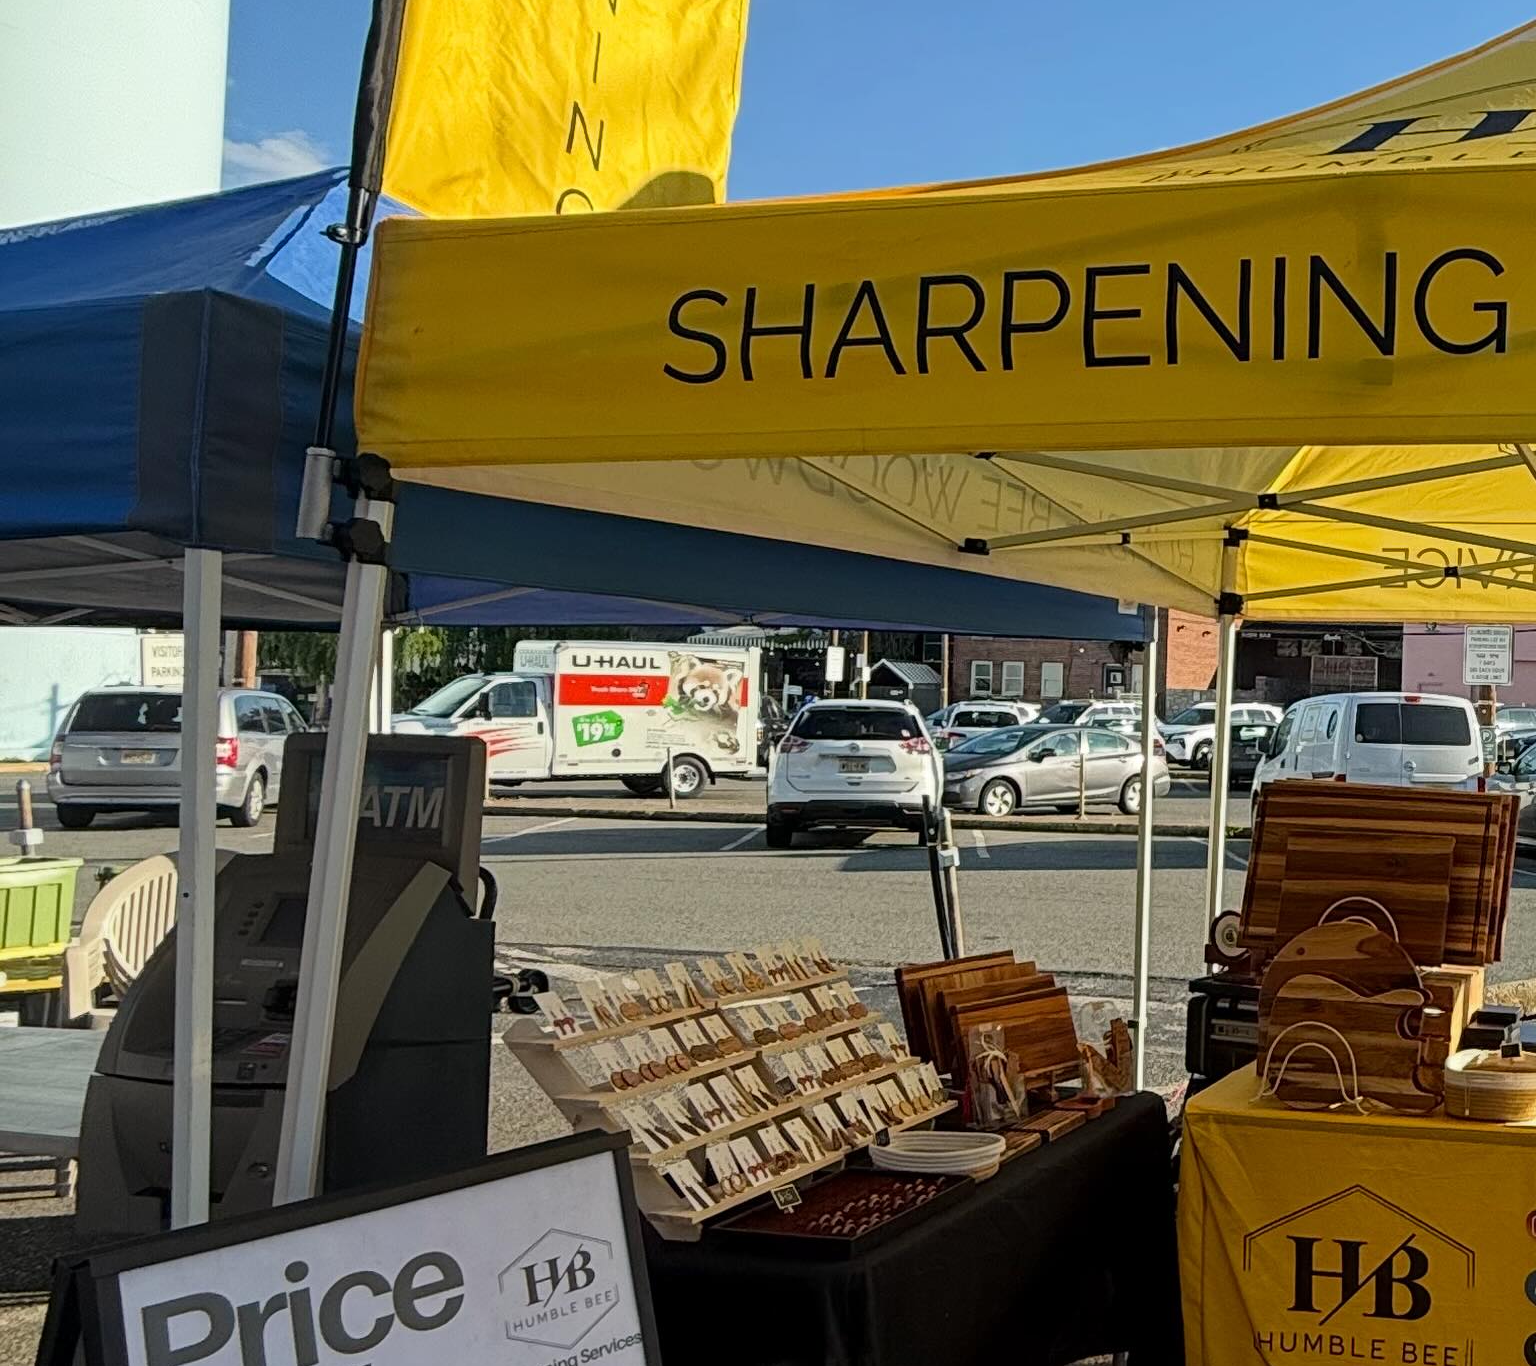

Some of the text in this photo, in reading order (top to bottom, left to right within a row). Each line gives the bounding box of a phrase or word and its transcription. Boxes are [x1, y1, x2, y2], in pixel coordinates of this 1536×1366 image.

[664, 247, 1508, 385] SHARPENING
[152, 667, 182, 677] PARKIN
[572, 654, 661, 669] U-HAUL
[360, 786, 445, 829] ATM
[513, 1290, 613, 1333] HUMBLE BEE
[580, 1332, 643, 1364] Services
[1257, 1331, 1386, 1360] HUMBLE
